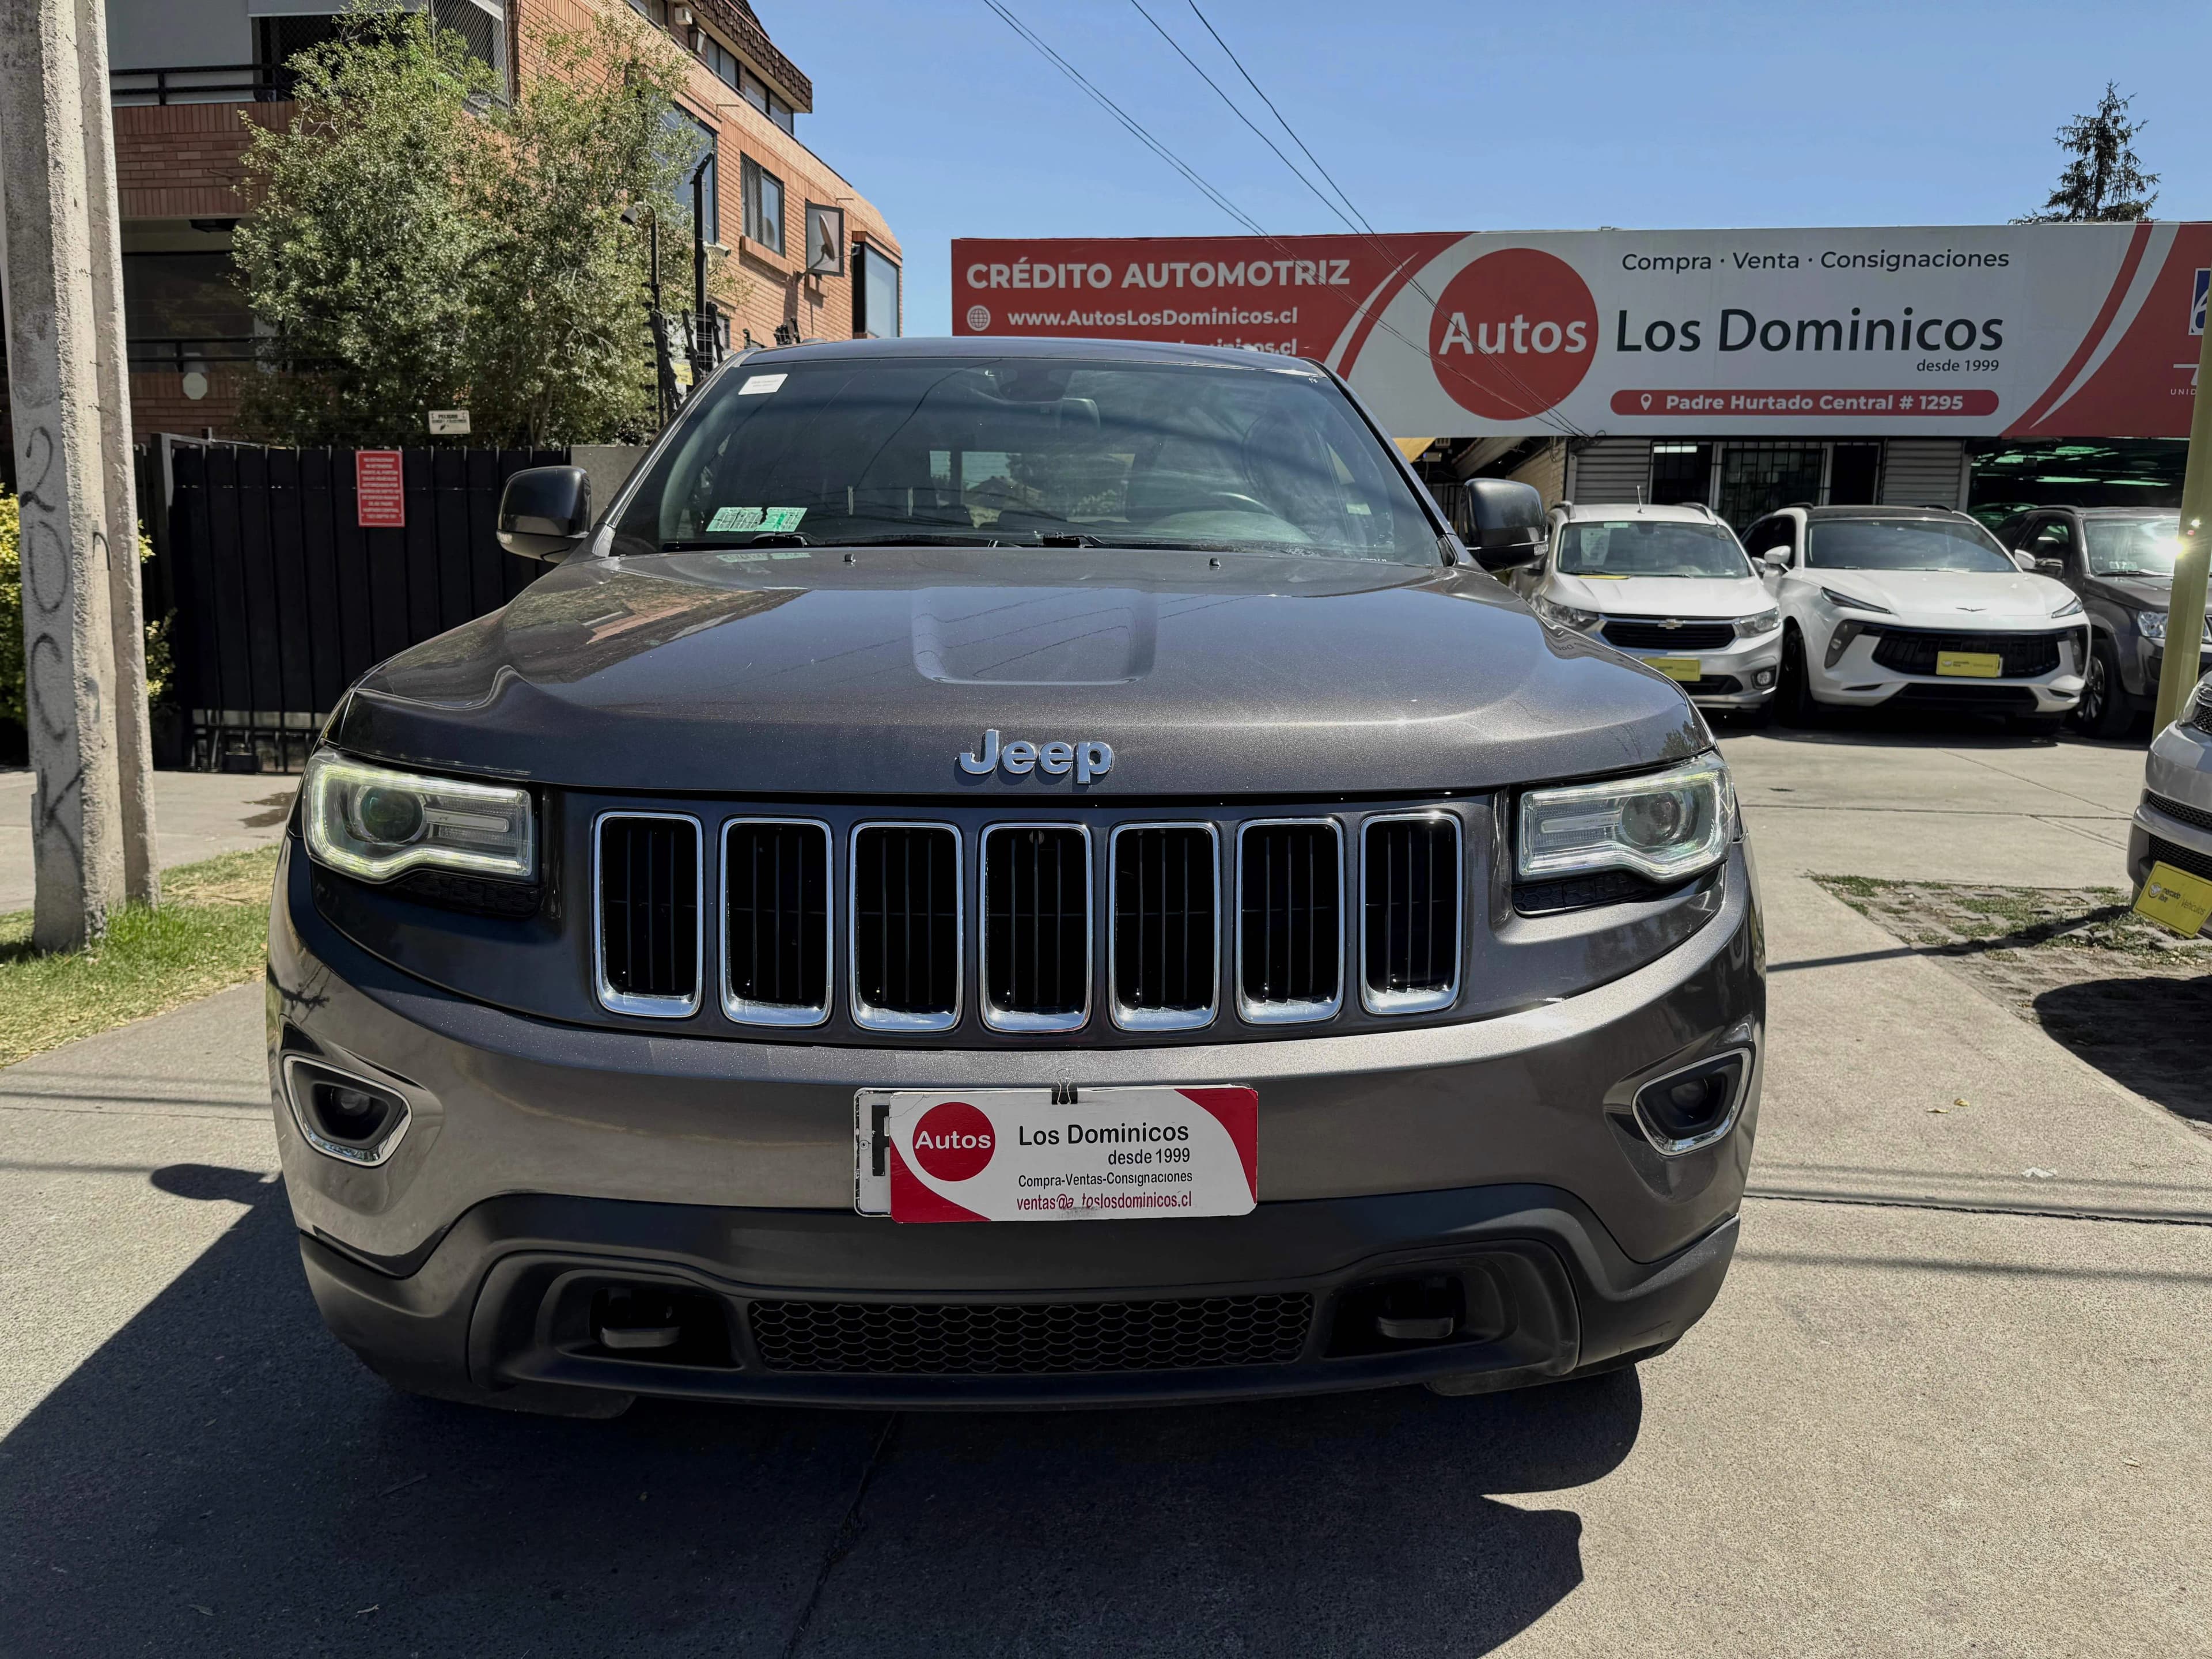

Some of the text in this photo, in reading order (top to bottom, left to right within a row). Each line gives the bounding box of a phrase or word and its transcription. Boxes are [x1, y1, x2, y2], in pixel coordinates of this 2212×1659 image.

[1622, 249, 2010, 274] Compra Venta Consignaciones
[967, 257, 1350, 289] CRÉDITO AUTOMOTRIZ
[1007, 306, 1298, 326] www.AutosLosDominicos.cl
[1438, 312, 1587, 355] Autos
[1616, 306, 2003, 352] Los Dominicos
[1916, 359, 1999, 372] desde 1999
[1666, 395, 1724, 410] Padre
[1730, 395, 1813, 410] Hurtado
[1819, 395, 1893, 410] Central
[1919, 395, 1964, 410] 1295
[959, 729, 1114, 784] Jeep
[915, 1130, 991, 1149] Autos
[1019, 1122, 1189, 1146] Los Dominicos
[1108, 1147, 1191, 1165] desde 1999
[1018, 1171, 1192, 1190] Compra-Ventas-Consignaciones
[1017, 1190, 1192, 1211] ventas@atoslosdominicos.cl
